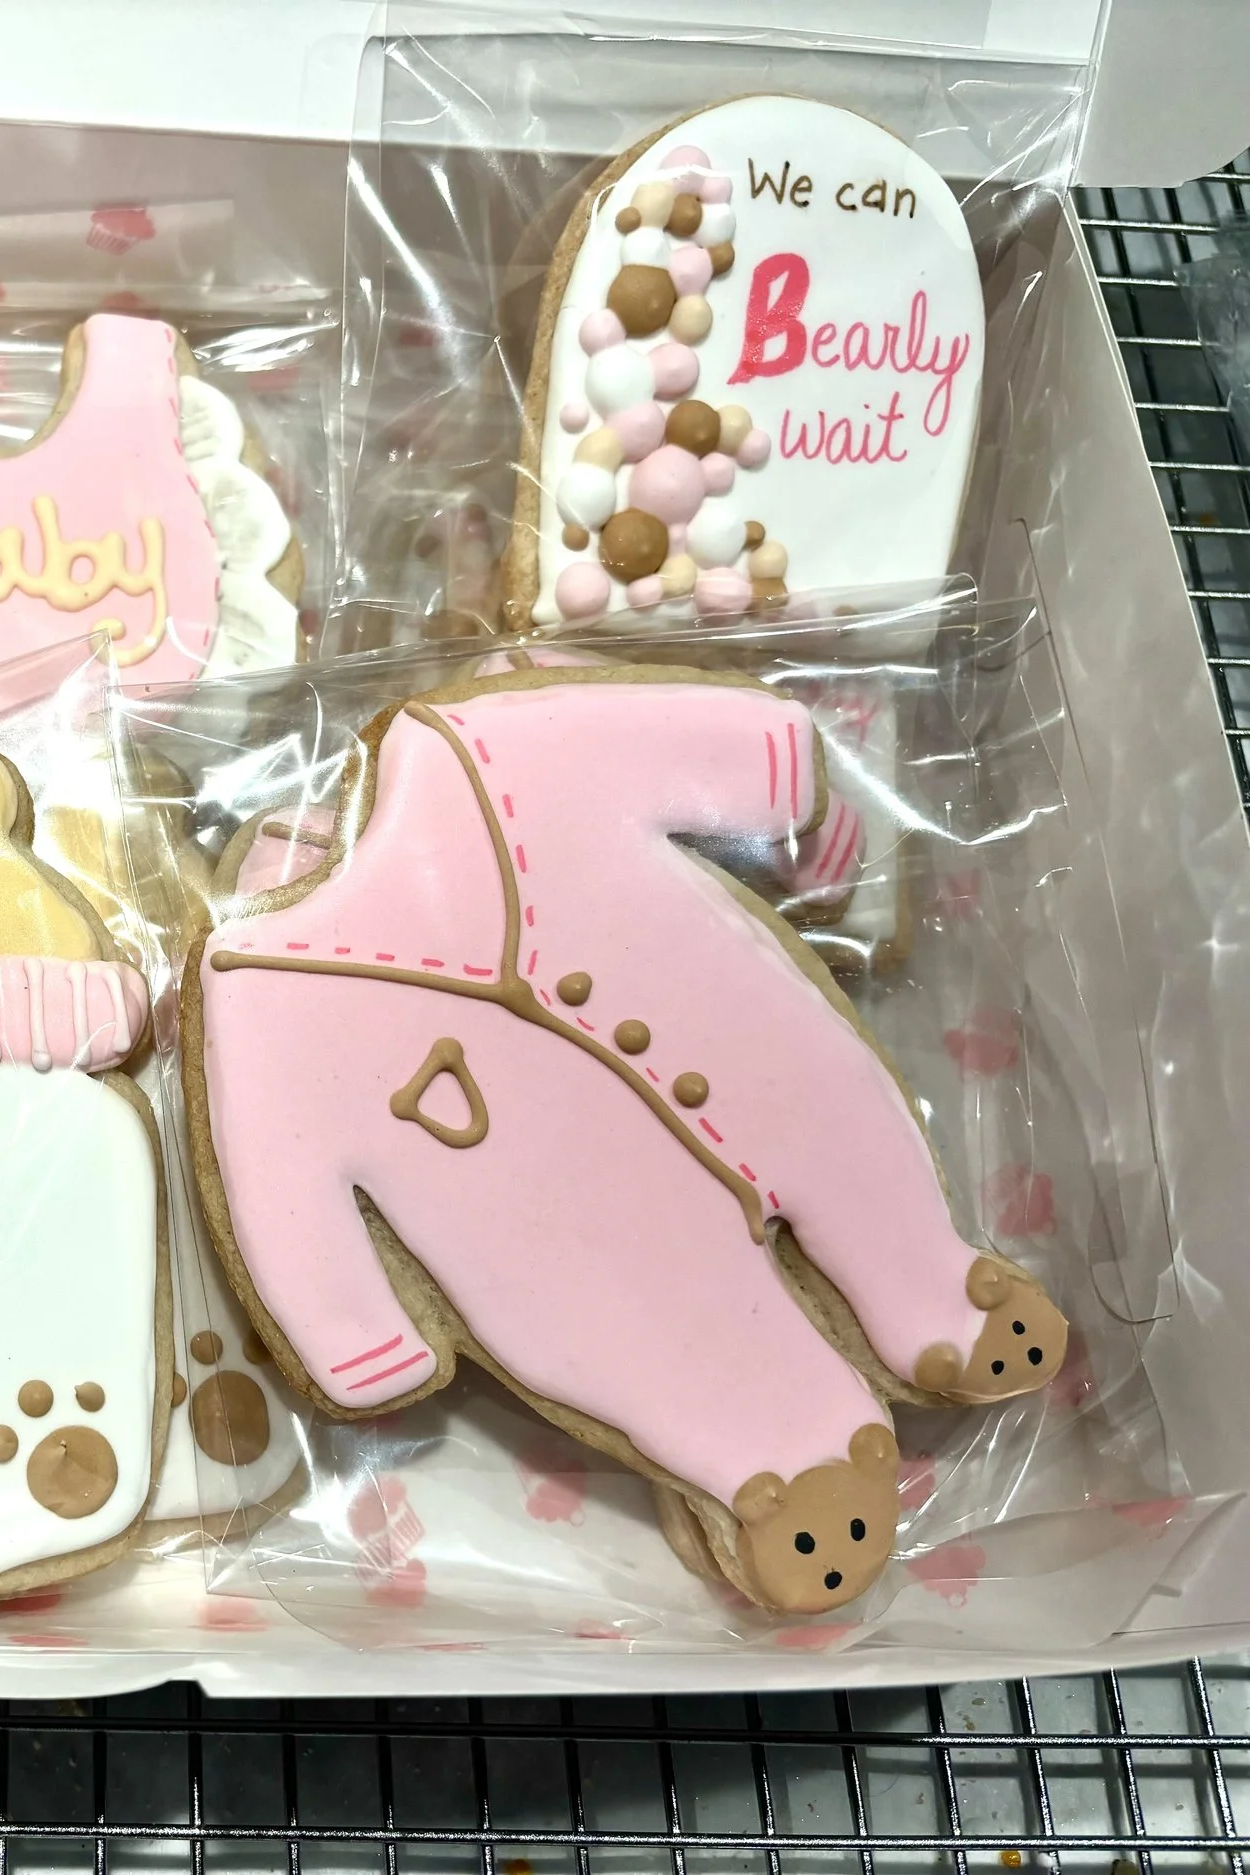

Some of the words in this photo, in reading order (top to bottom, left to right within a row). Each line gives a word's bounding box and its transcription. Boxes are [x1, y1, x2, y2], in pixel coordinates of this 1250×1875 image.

[748, 157, 813, 208] We
[835, 180, 918, 219] can
[726, 252, 970, 437] Bearly
